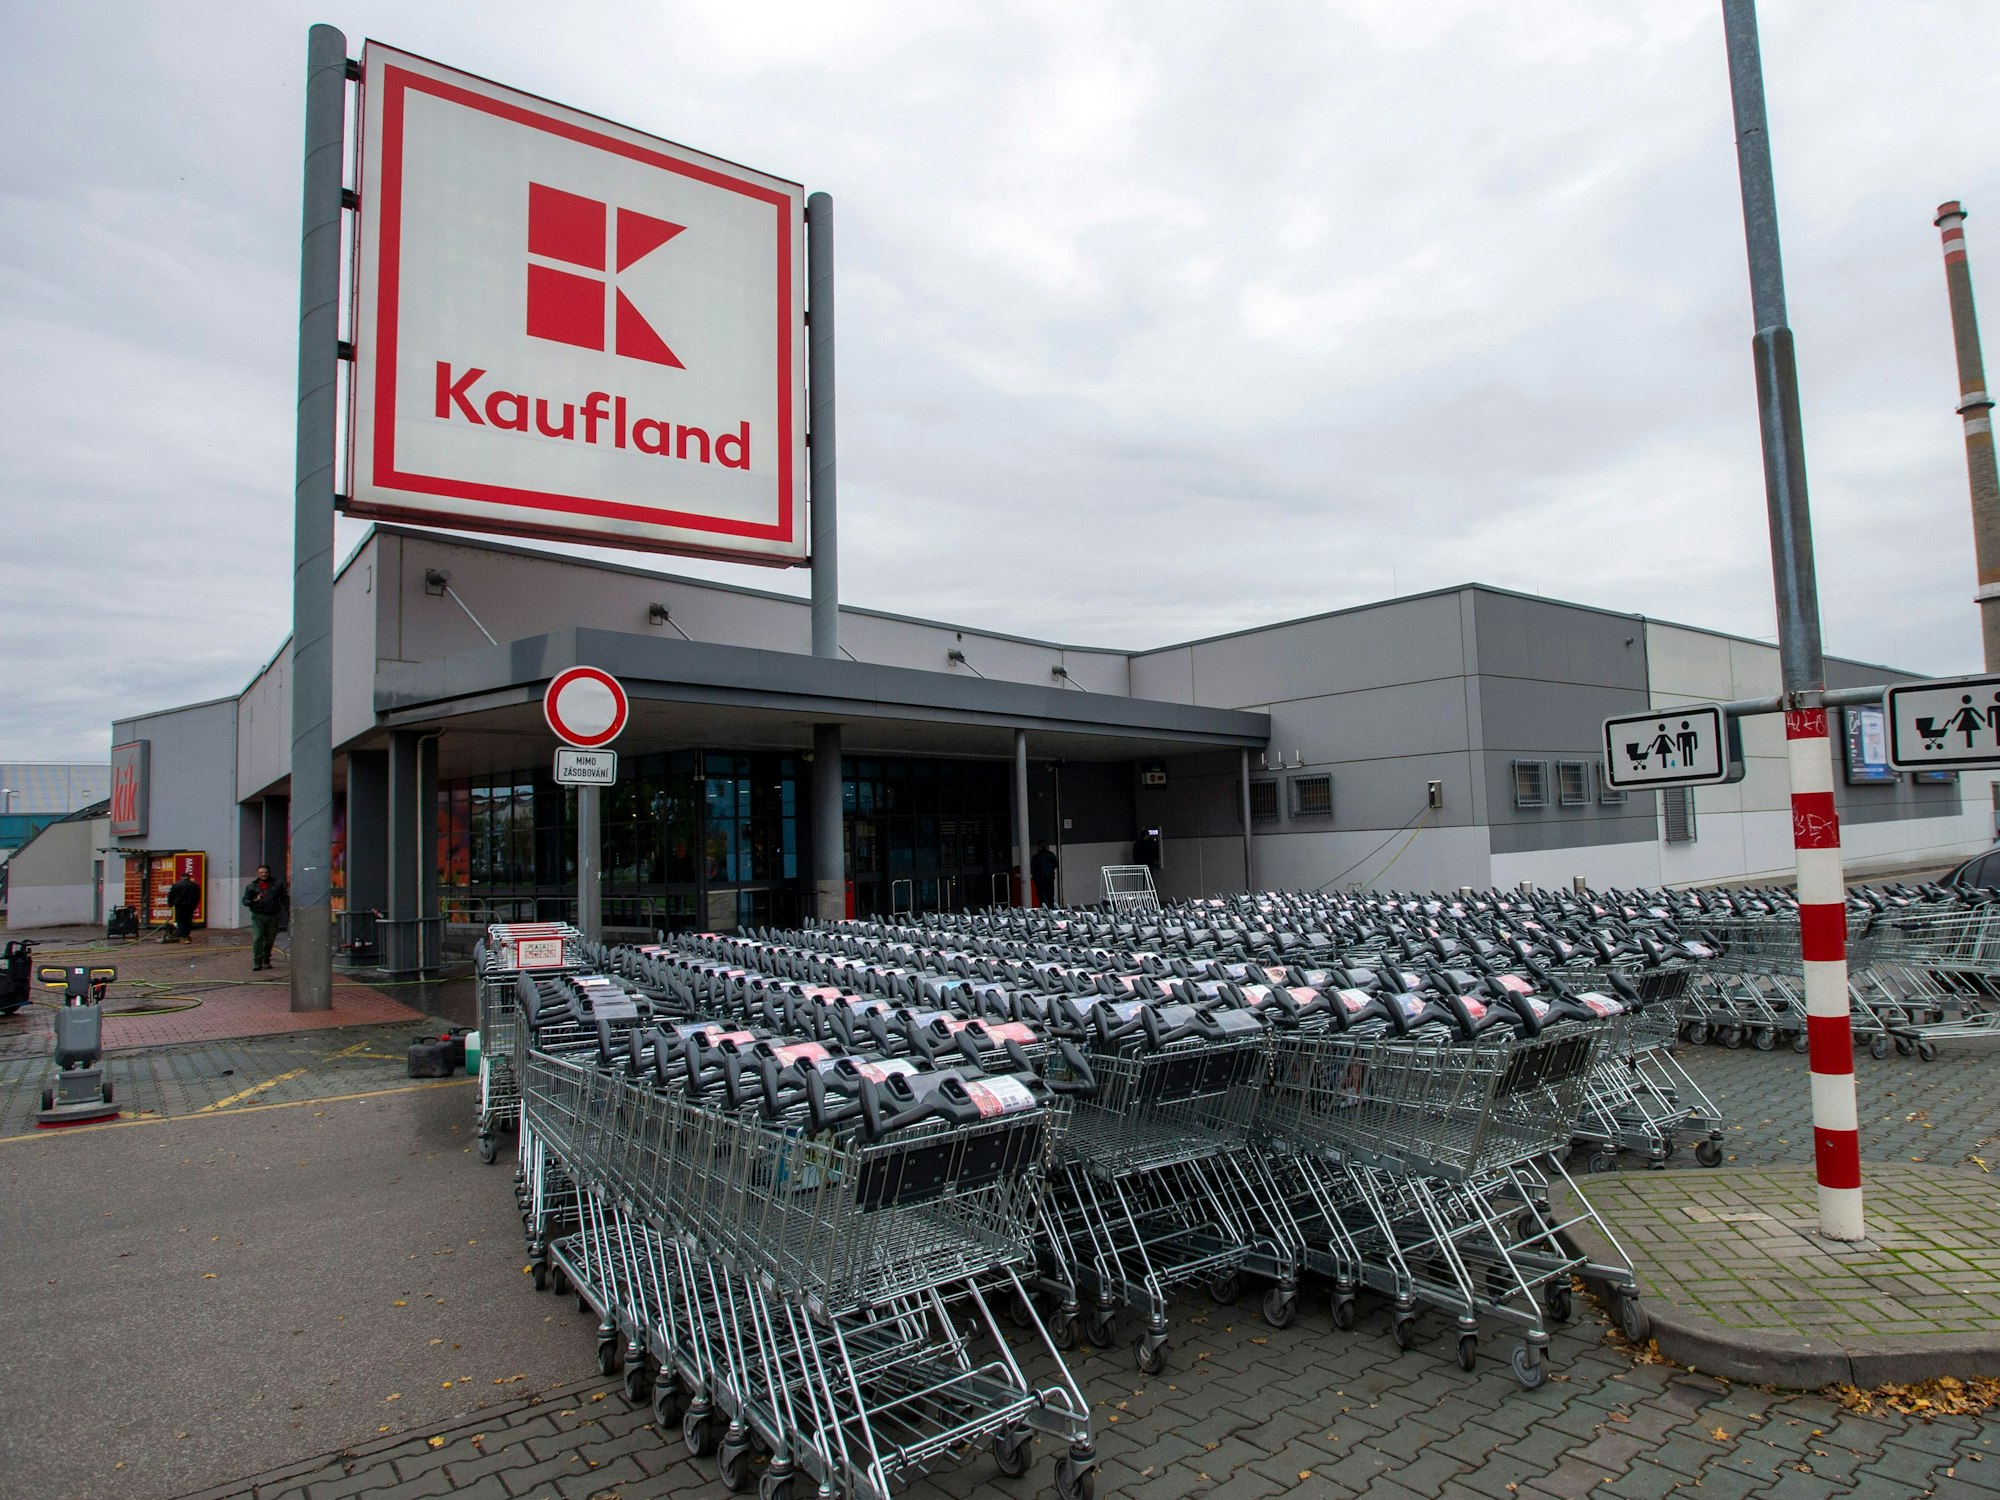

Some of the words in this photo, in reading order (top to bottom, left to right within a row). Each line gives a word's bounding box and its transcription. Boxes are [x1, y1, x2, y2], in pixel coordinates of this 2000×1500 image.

[435, 360, 750, 471] Kaufland
[576, 757, 597, 766] MIMO
[563, 767, 609, 778] ZÁSOBOVÁNÍ
